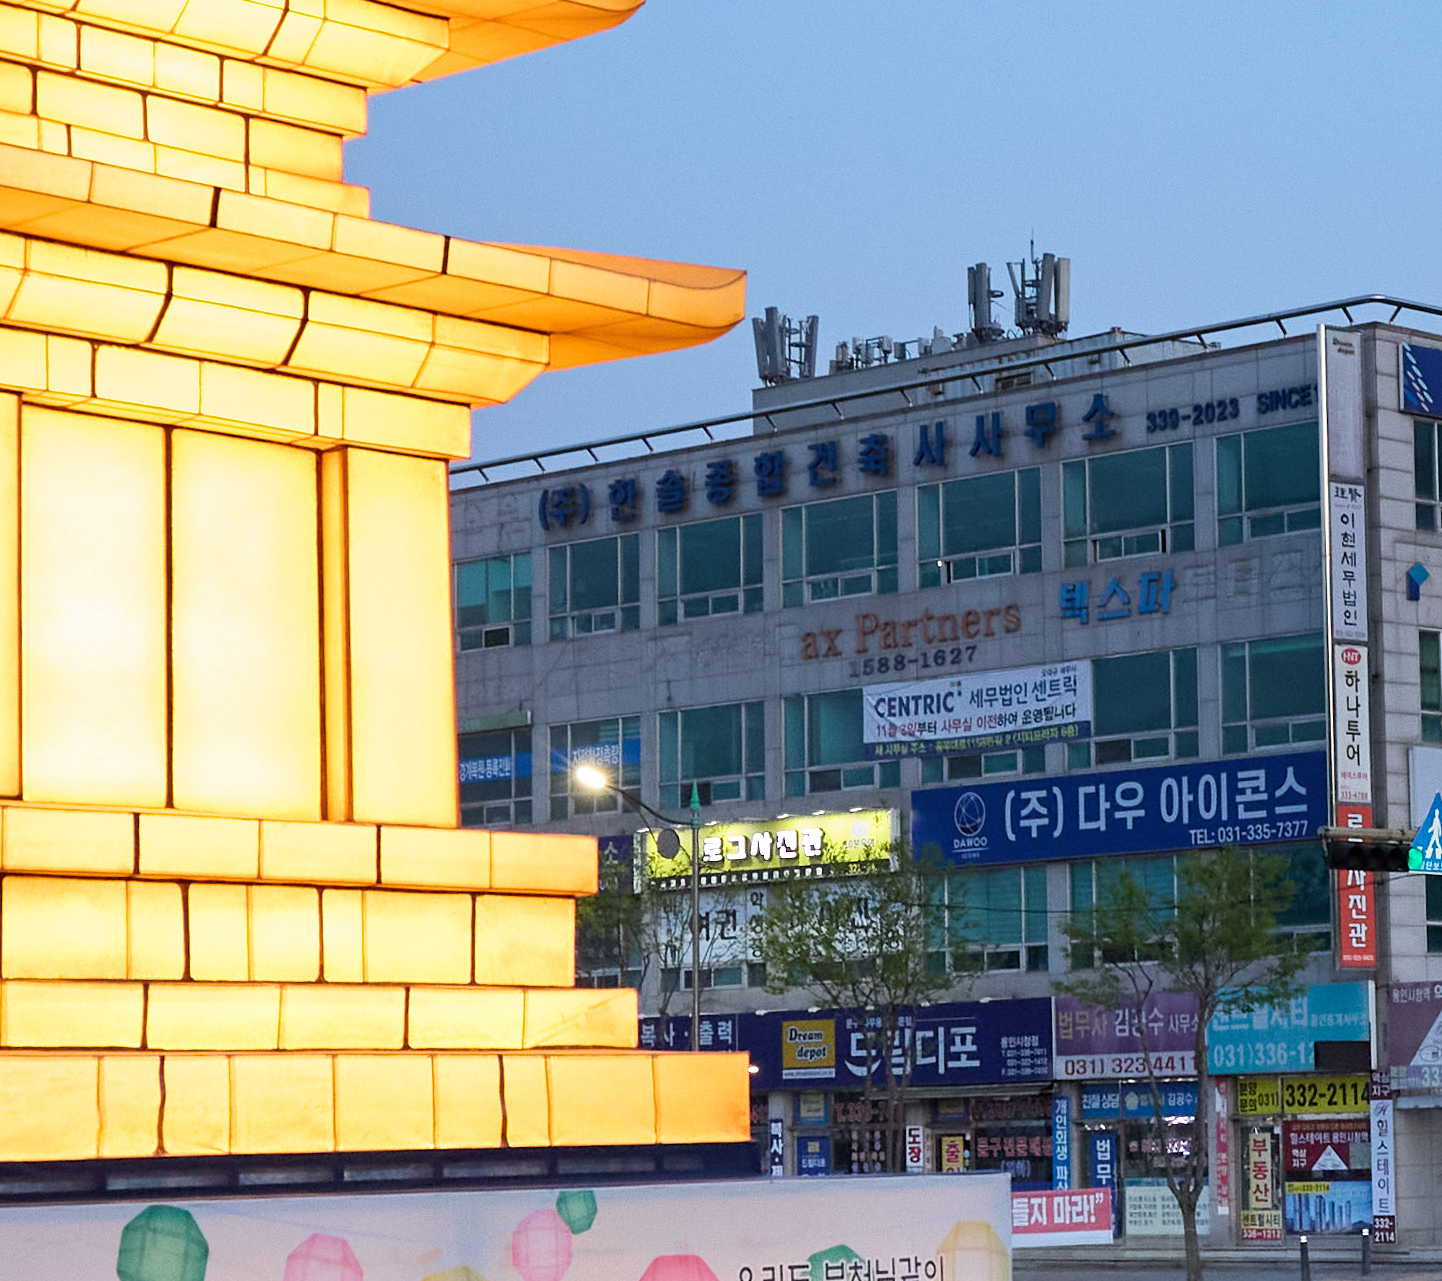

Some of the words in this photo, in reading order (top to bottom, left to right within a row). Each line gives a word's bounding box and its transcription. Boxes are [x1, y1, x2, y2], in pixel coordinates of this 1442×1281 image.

[855, 603, 1021, 654] Partners
[850, 646, 977, 678] 1588-1627
[875, 691, 955, 718] CENTRIC
[970, 684, 1028, 708] 세무법인
[1032, 676, 1077, 701] 센트릭
[977, 712, 1018, 730] 이전하여
[1345, 670, 1361, 766] 하나투어
[1005, 787, 1063, 841] (주)
[1078, 781, 1145, 831] 다우
[1160, 767, 1308, 824] 아이콘스
[703, 828, 824, 862] 로그사진관
[953, 837, 987, 849] DAWOO
[1189, 829, 1214, 845] TEL:
[1218, 820, 1308, 843] 031-335-7377
[699, 1020, 732, 1045] 출력
[788, 1026, 824, 1043] Dream
[795, 1044, 828, 1061] depot
[1286, 1082, 1370, 1106] 332-2114
[1372, 1085, 1391, 1096] 지구
[908, 1128, 922, 1163] 도장
[1251, 1138, 1269, 1203] 부동산
[1377, 1119, 1389, 1214] 힐스테이트
[1375, 1231, 1394, 1242] 2114
